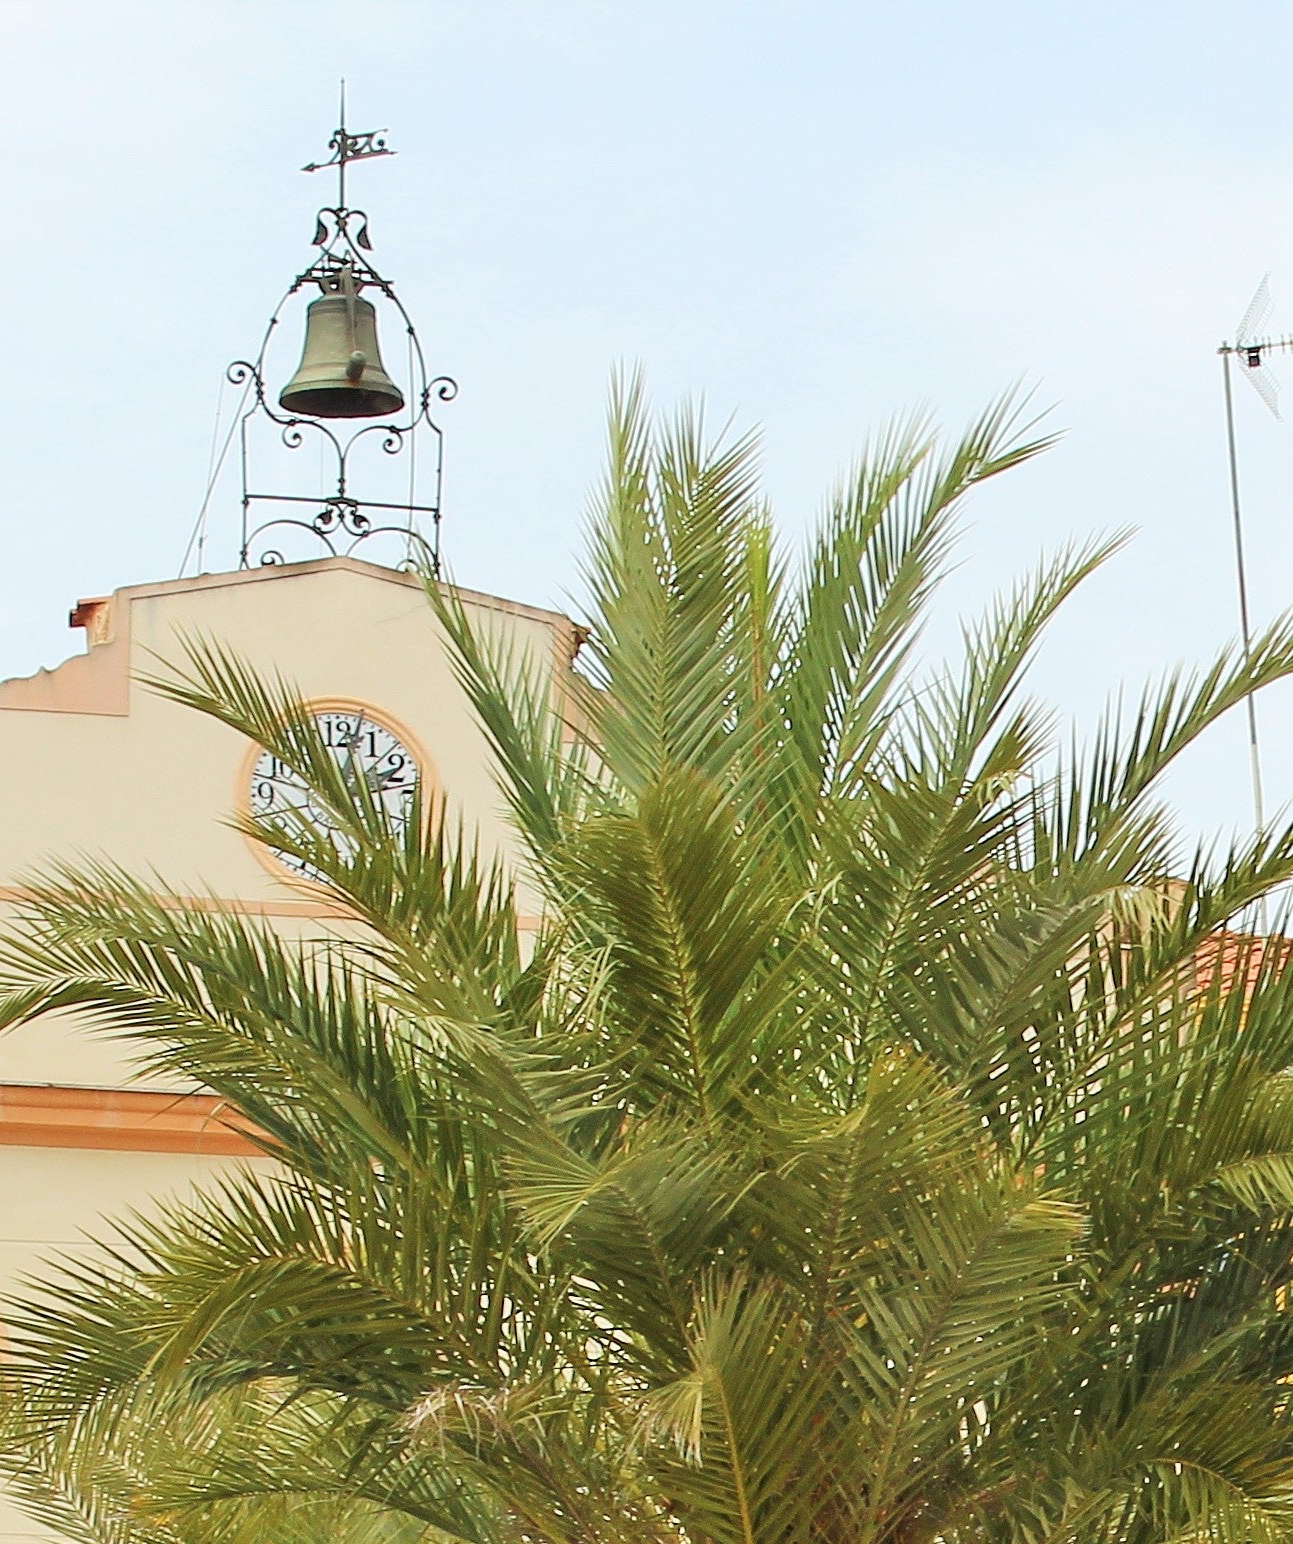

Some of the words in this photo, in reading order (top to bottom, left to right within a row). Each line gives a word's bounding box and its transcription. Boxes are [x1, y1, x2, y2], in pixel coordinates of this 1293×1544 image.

[325, 721, 351, 747] 12
[365, 732, 378, 757] 1
[387, 754, 405, 782] 2
[258, 781, 274, 810] 9
